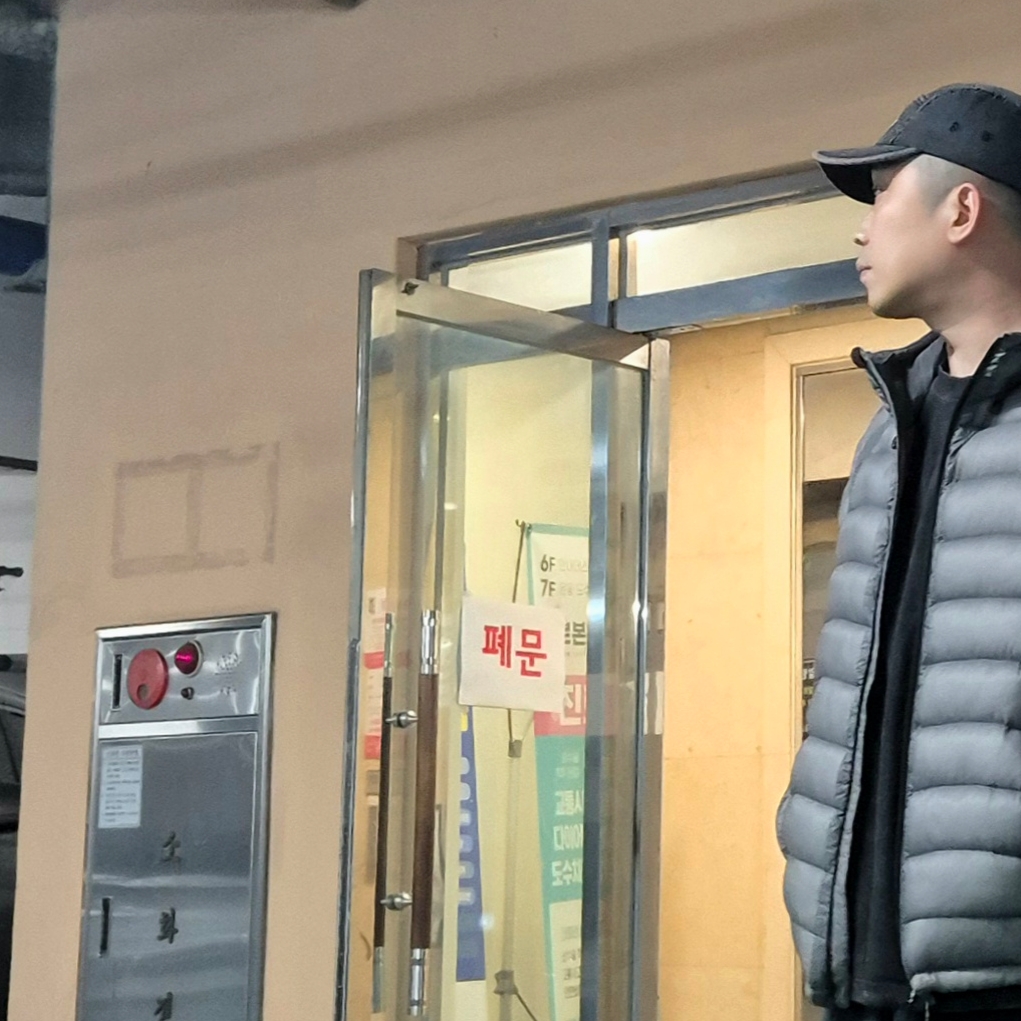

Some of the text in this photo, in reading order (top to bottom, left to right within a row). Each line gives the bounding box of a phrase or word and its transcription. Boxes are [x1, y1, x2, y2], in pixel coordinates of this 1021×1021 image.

[540, 554, 556, 573] 6F
[540, 578, 556, 597] 7F
[482, 624, 547, 678] 폐문
